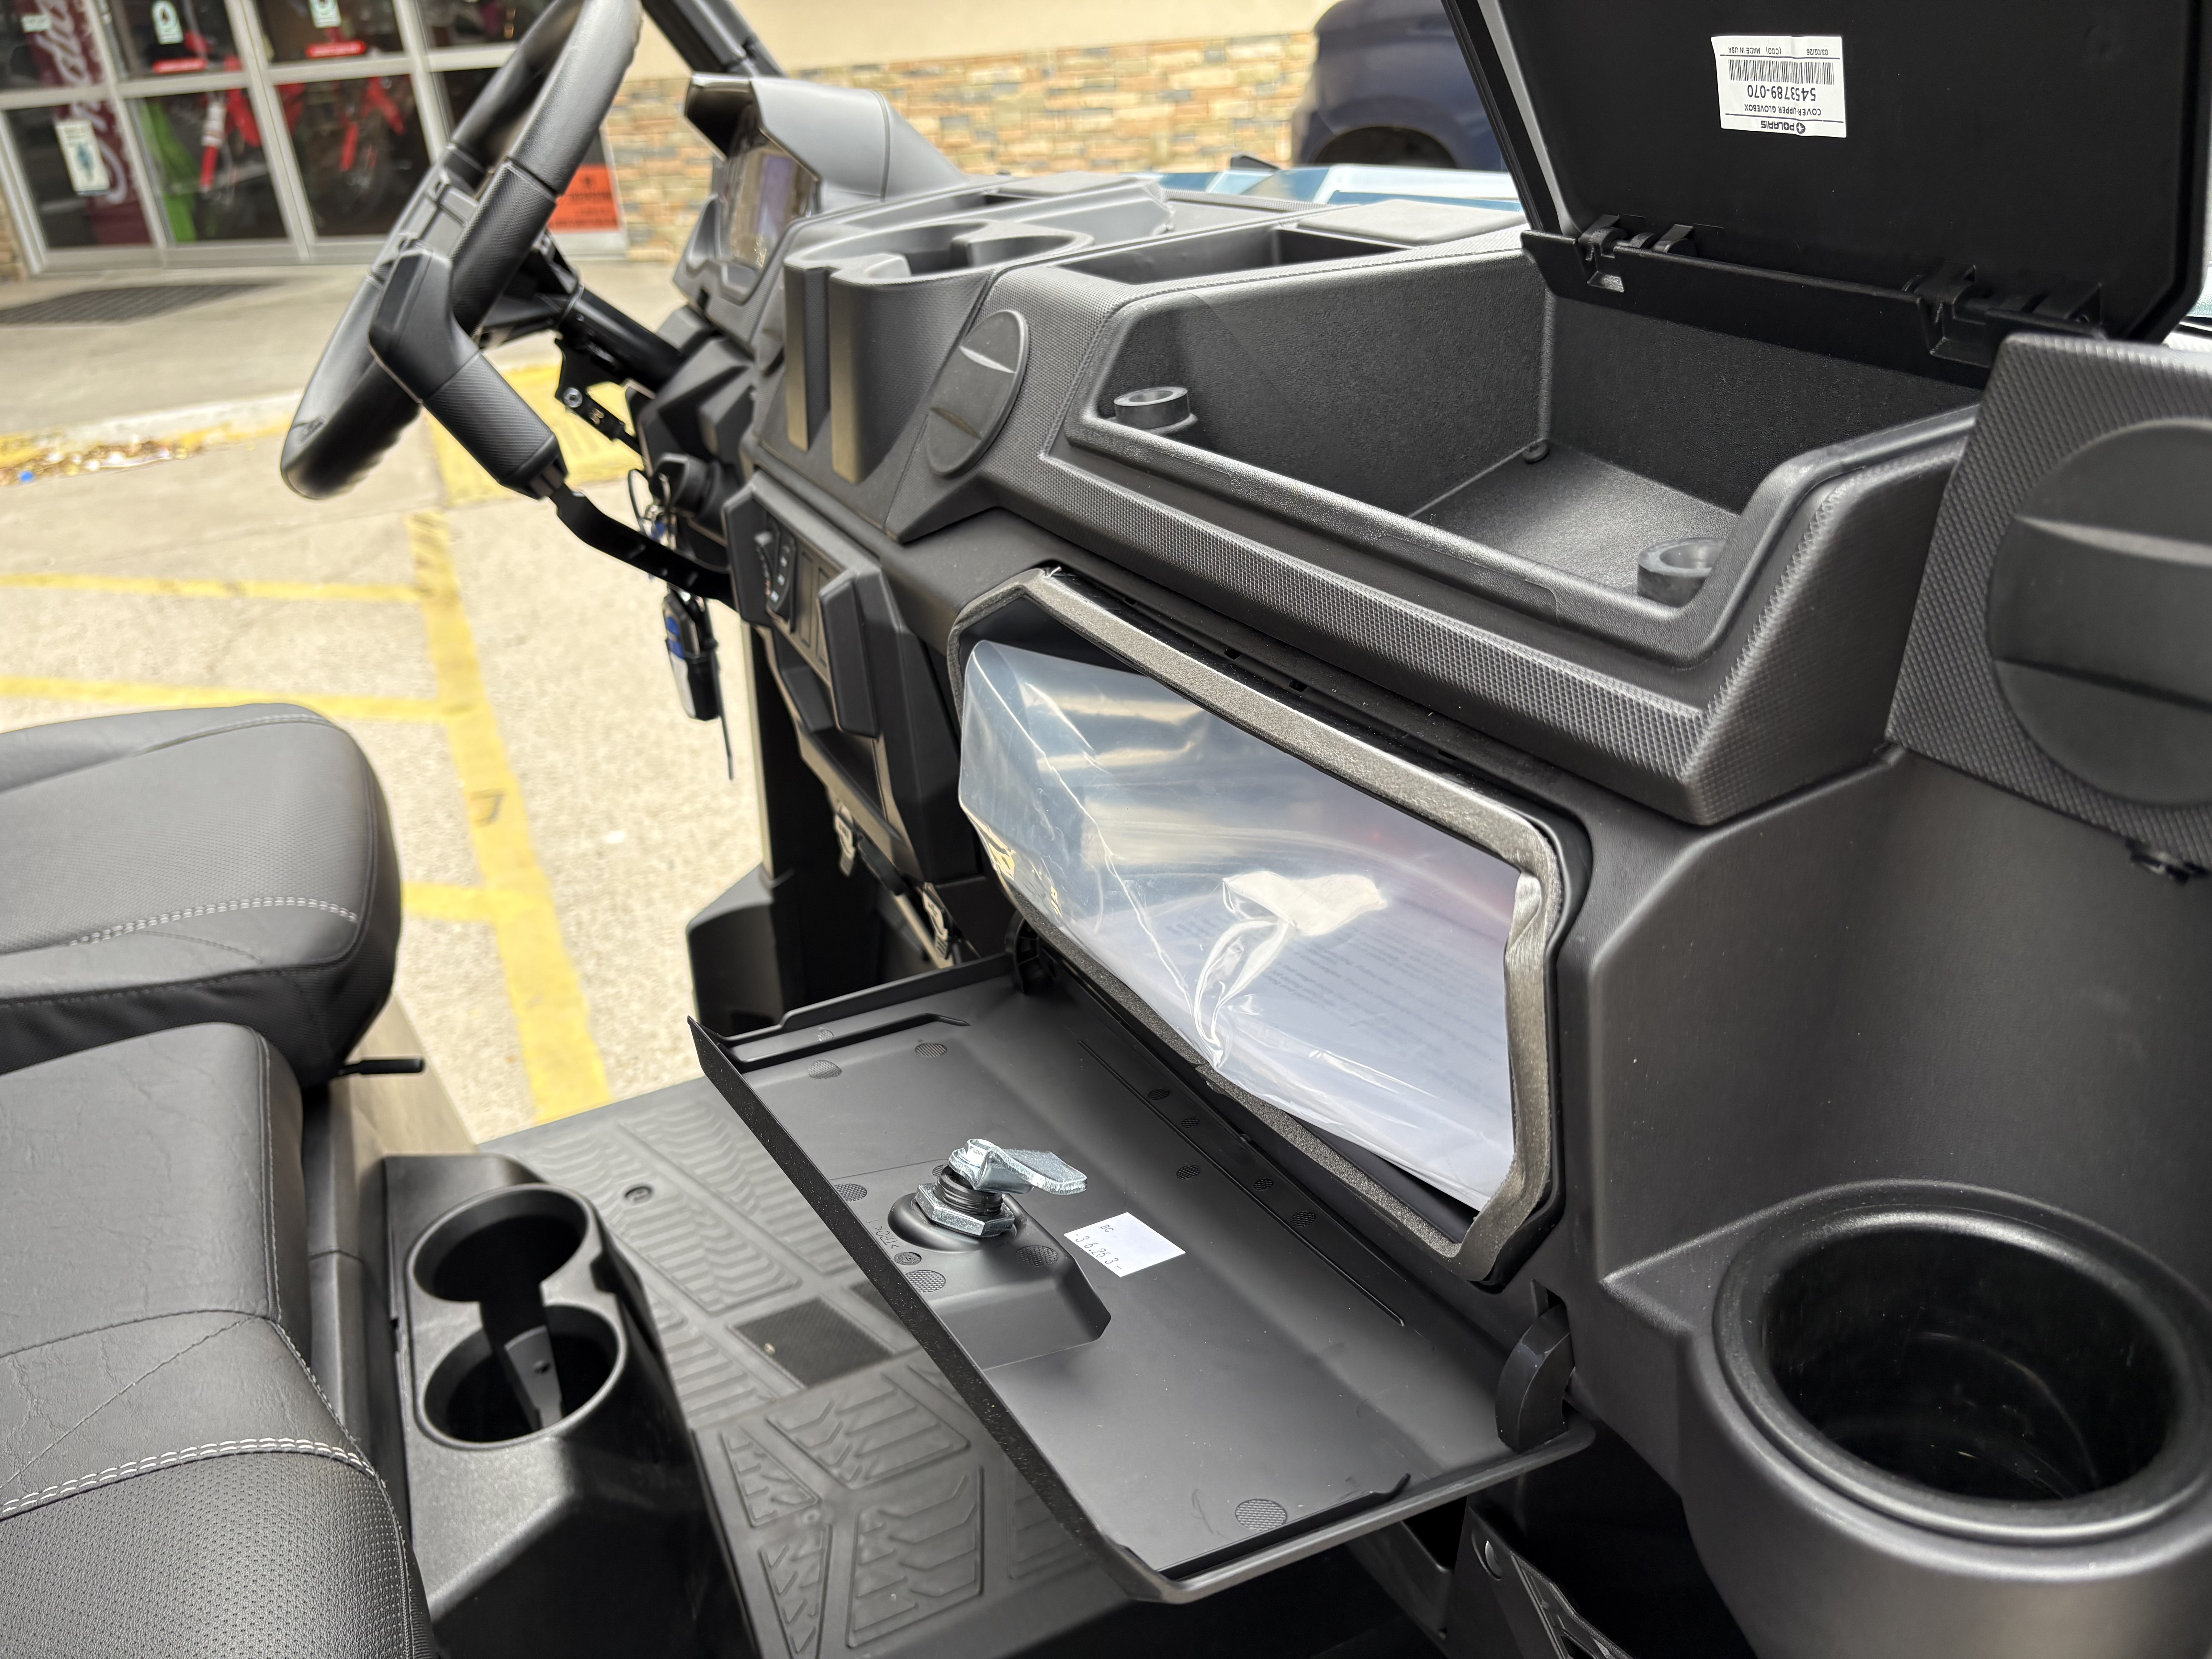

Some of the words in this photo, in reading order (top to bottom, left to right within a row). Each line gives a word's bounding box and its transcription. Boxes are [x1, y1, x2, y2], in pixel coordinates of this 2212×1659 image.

[1766, 46, 1781, 55] (COO)
[1747, 84, 1816, 101] 5453789-070
[1744, 104, 1776, 113] GLOVEBOX
[1760, 120, 1795, 131] POLARIS
[1100, 1224, 1114, 1232] BC
